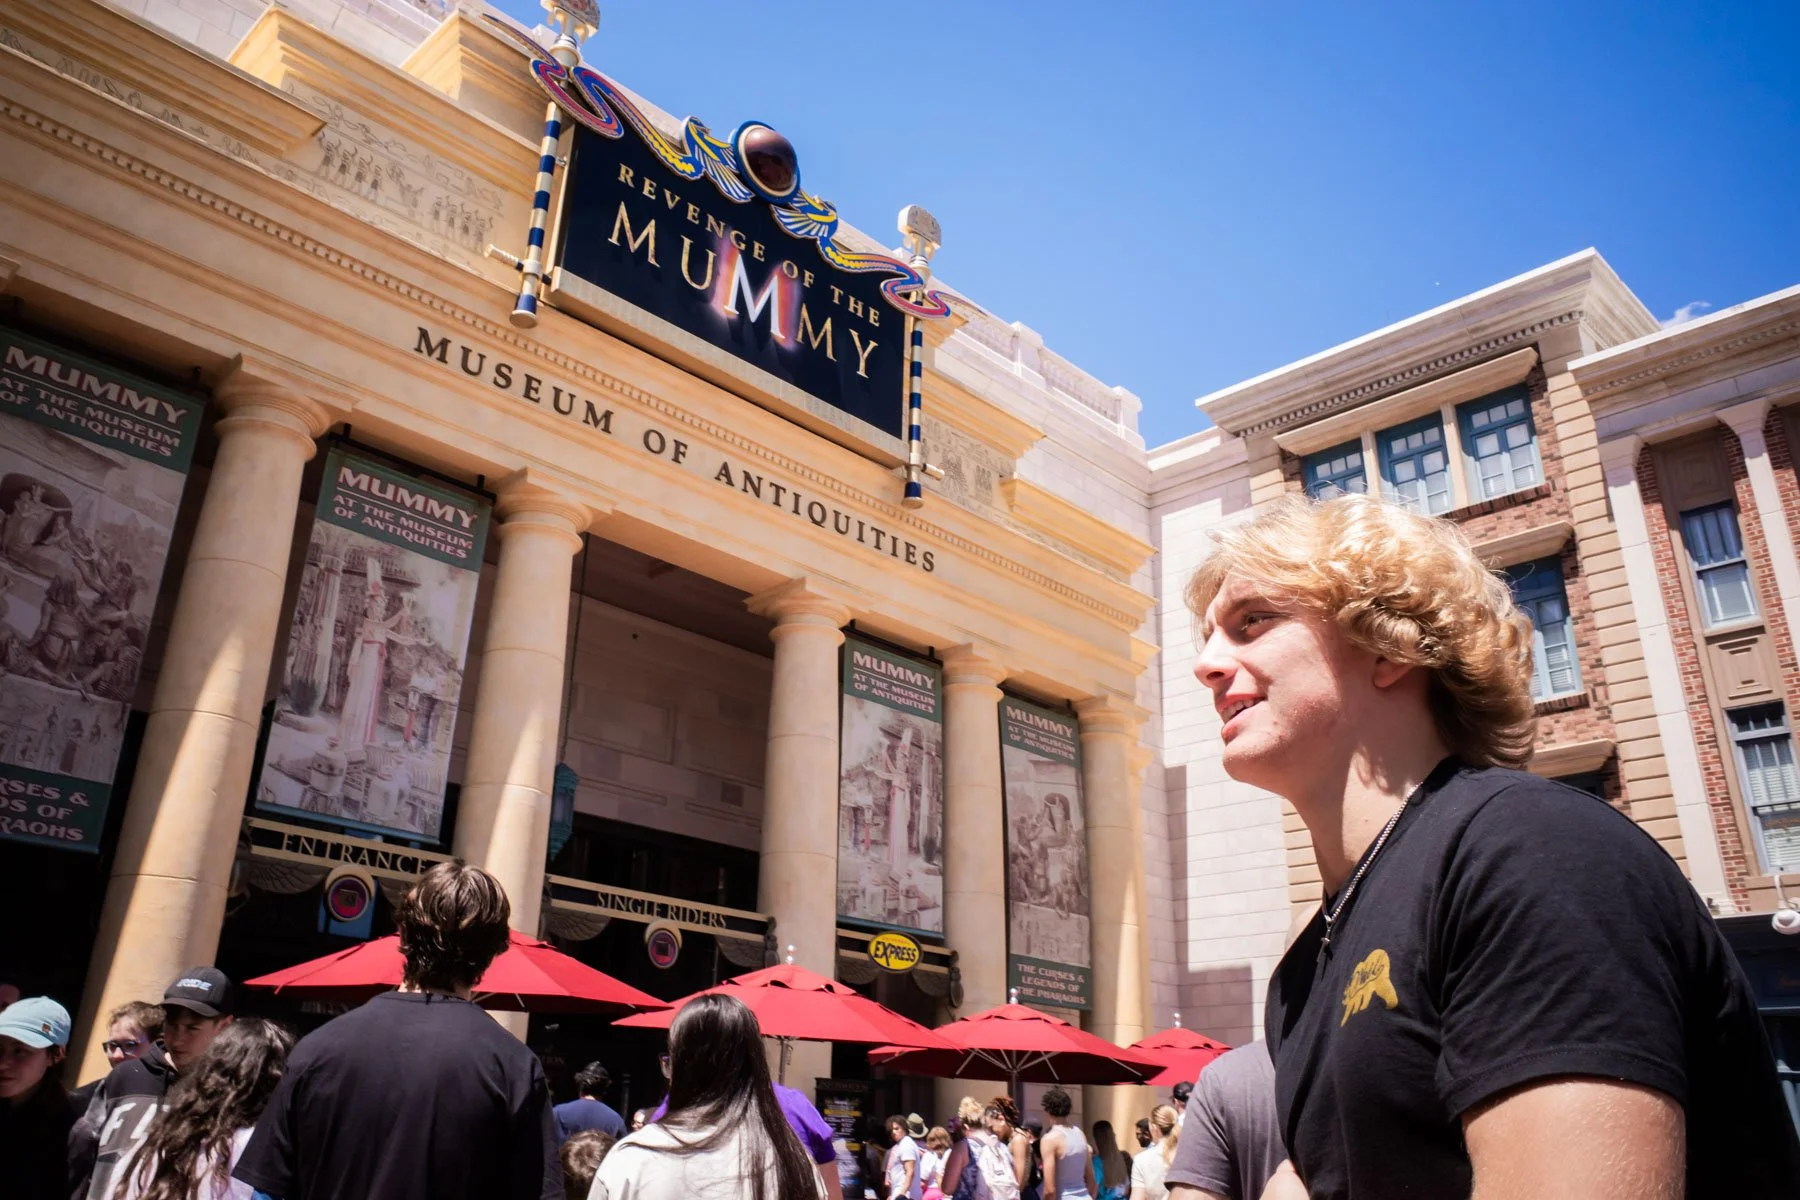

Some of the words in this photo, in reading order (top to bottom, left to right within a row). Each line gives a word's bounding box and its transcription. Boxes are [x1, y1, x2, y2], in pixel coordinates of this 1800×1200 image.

[618, 163, 765, 262] REVENGE
[782, 260, 815, 288] OF
[830, 285, 880, 327] THE
[608, 201, 879, 379] MUMMY
[5, 346, 188, 424] MUMMY
[0, 376, 30, 392] AT
[35, 388, 79, 411] THE
[85, 406, 180, 448] MUSEUM
[0, 390, 31, 405] OF
[36, 403, 172, 457] ANTIQUITIES
[414, 326, 615, 435] MUSEUM
[643, 429, 689, 464] OF
[715, 461, 936, 573] ANTIQUITIES
[338, 467, 478, 529] MUMMY
[332, 494, 357, 507] AT
[362, 501, 395, 521] THE
[396, 516, 473, 549] MUSEUM
[334, 508, 357, 519] OF
[361, 516, 467, 559] ANTIQUITIES
[852, 673, 868, 682] AT
[870, 677, 890, 691] THE
[891, 685, 935, 705] MUSEUM
[853, 651, 935, 689] MUMMY
[854, 682, 868, 691] OF
[871, 687, 933, 713] ANTIQUITIES
[1006, 705, 1073, 738] MUMMY
[37, 804, 73, 819] OF
[69, 792, 90, 807] &
[282, 832, 429, 875] ENTRANCE
[596, 891, 662, 917] SINGLE
[667, 905, 727, 928] RIDERS
[874, 941, 916, 967] EXPRESS
[1016, 963, 1037, 974] THE
[1021, 975, 1065, 990] LEGENDS
[1067, 983, 1080, 992] OF
